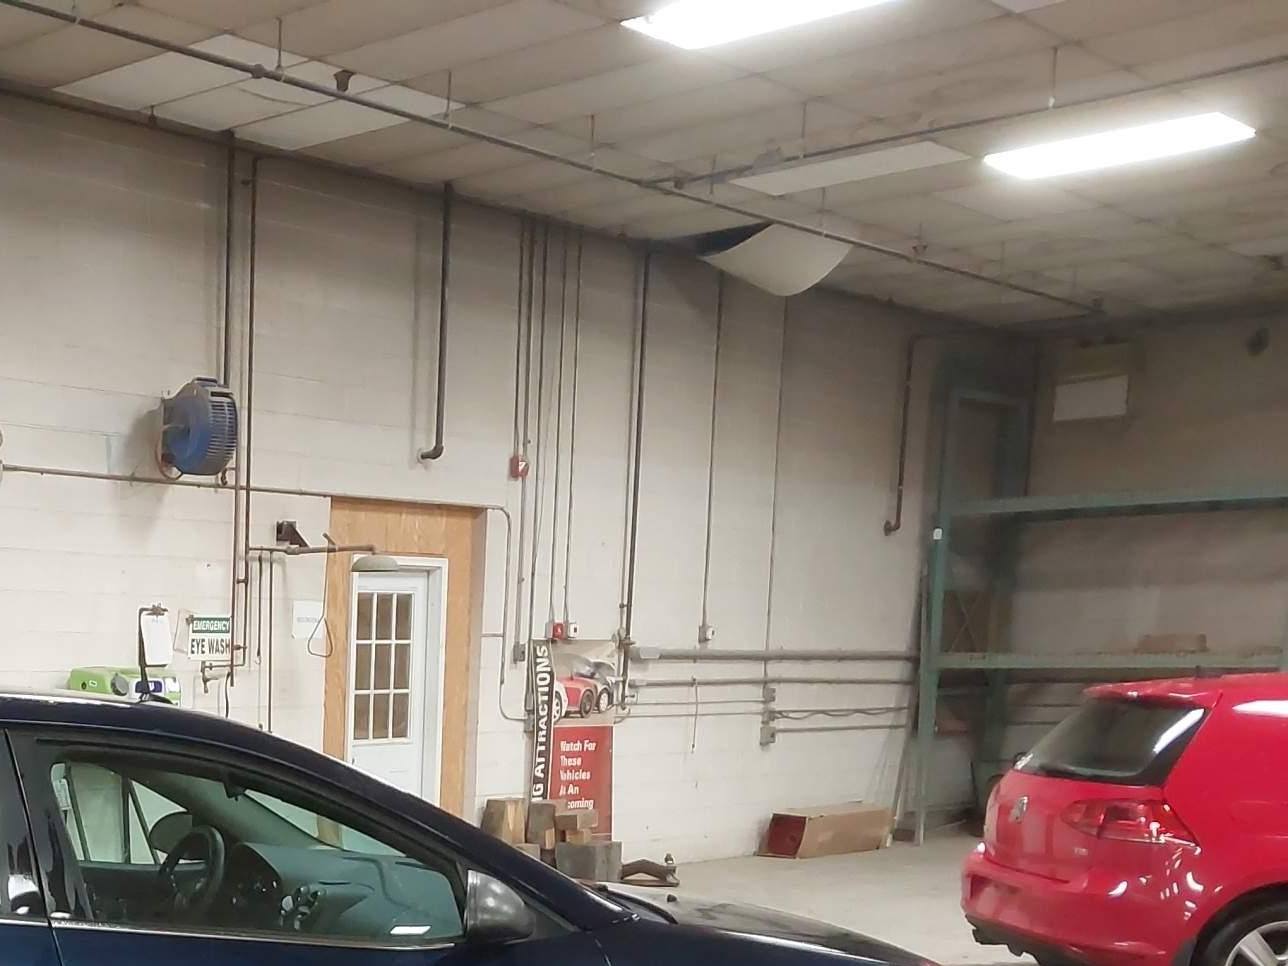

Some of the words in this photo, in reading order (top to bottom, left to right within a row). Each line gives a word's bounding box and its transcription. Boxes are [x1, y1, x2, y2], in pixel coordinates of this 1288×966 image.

[193, 620, 230, 631] EMERGENCY
[191, 638, 205, 654] EYE
[207, 637, 231, 655] WASH
[534, 645, 551, 778] ATTRACTIONS
[583, 740, 596, 751] For
